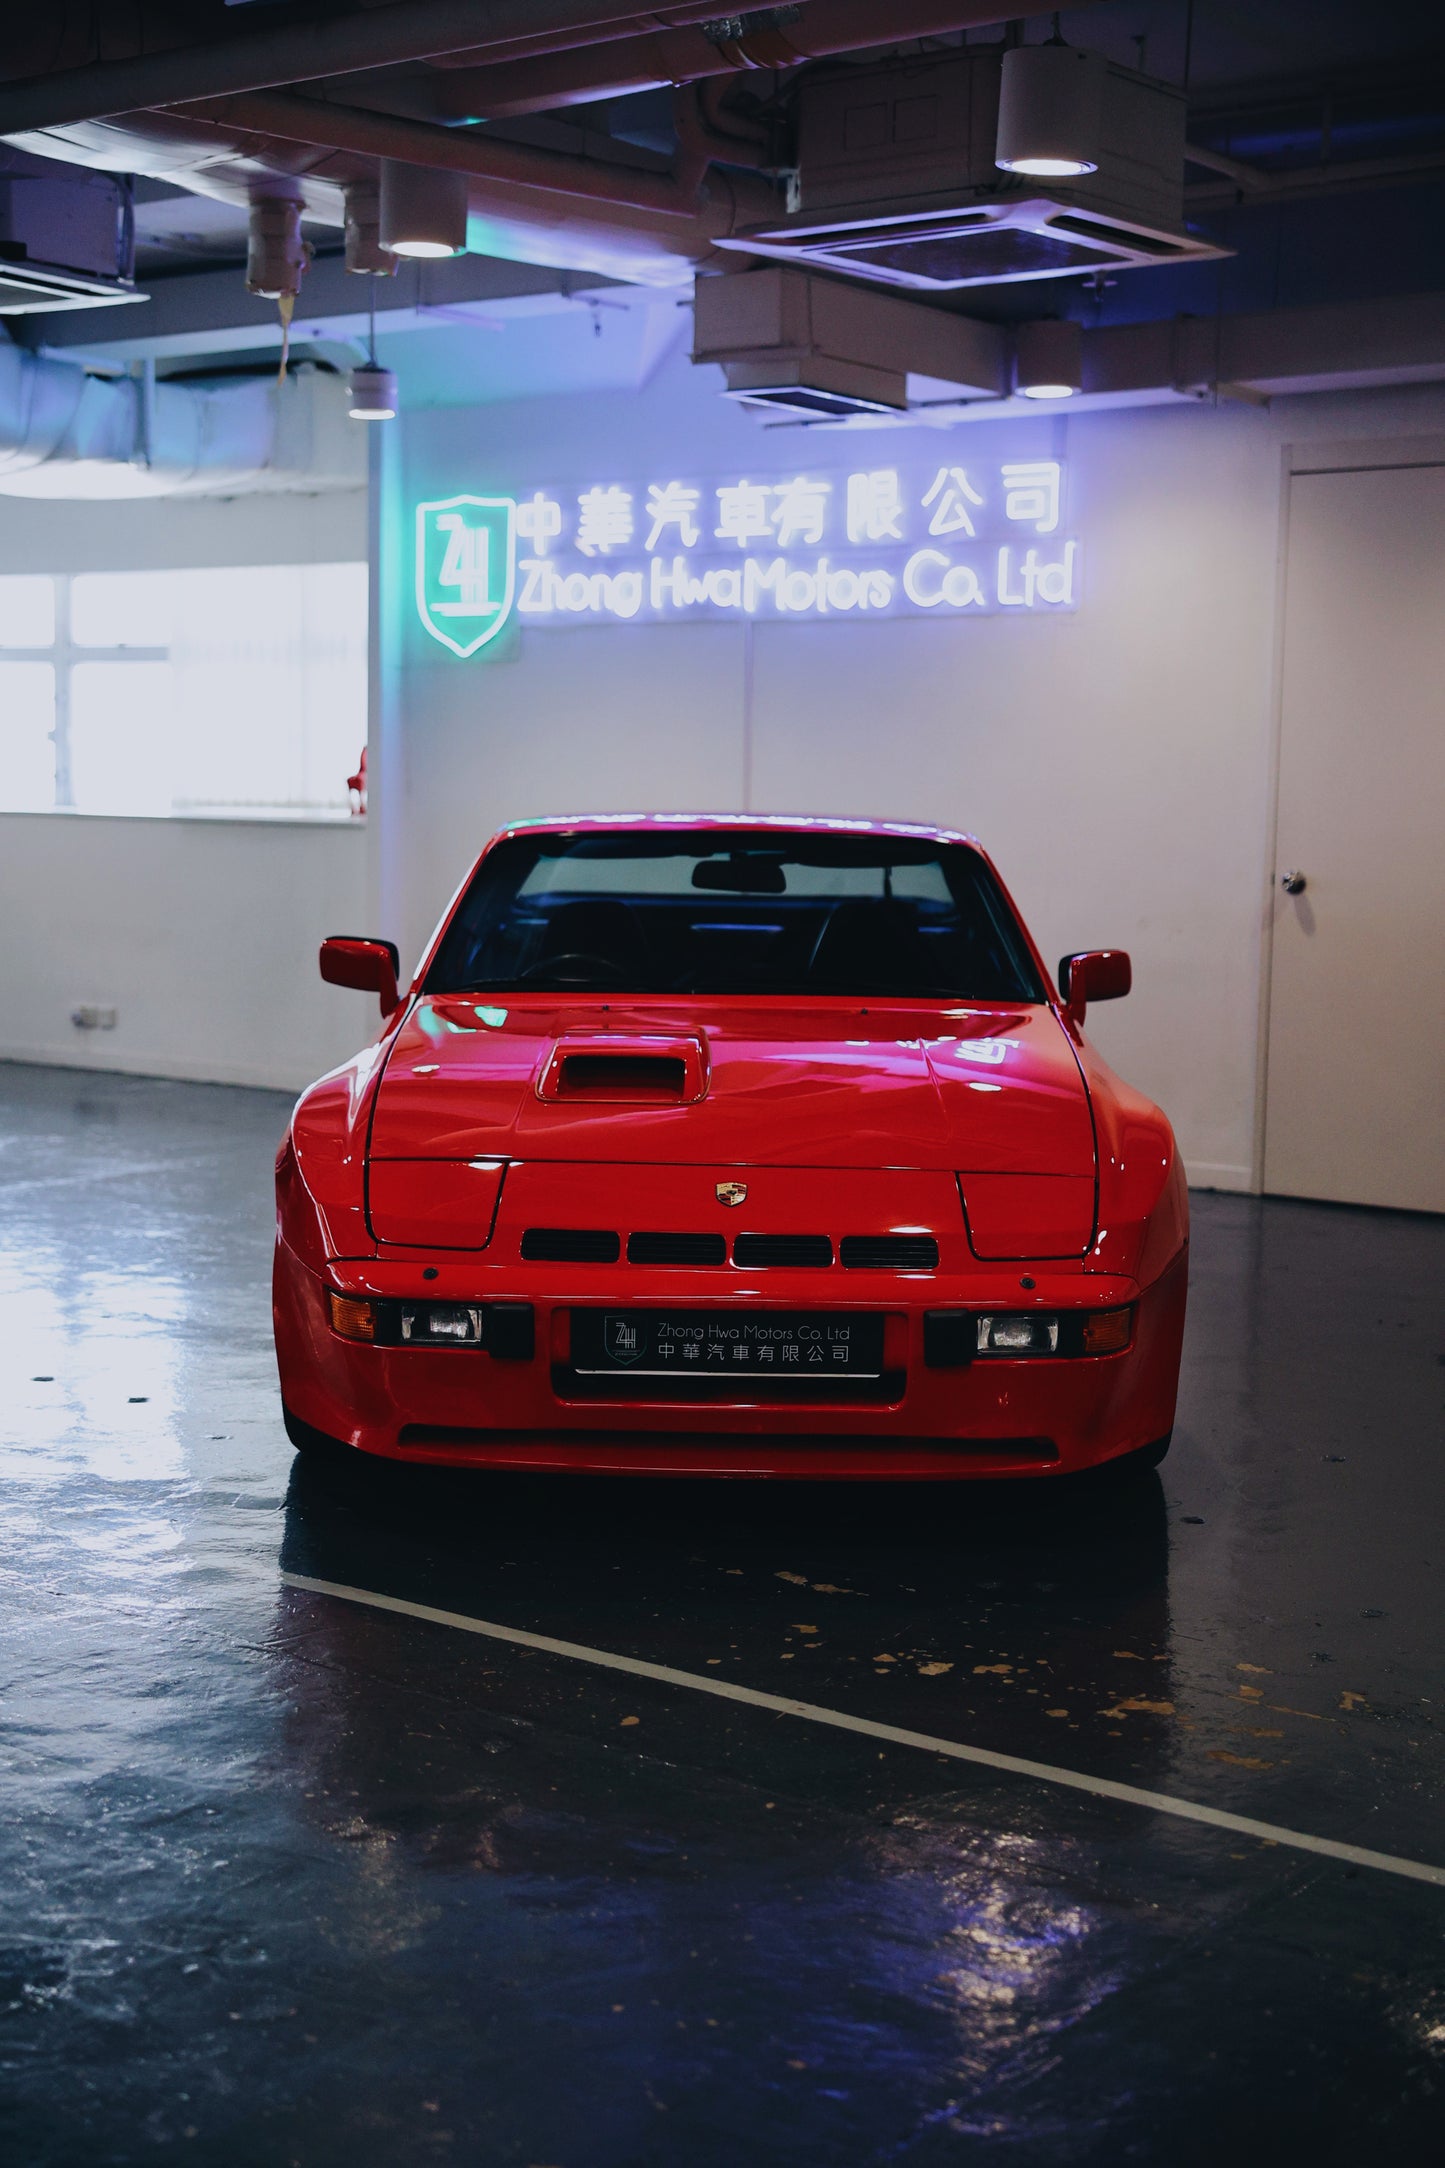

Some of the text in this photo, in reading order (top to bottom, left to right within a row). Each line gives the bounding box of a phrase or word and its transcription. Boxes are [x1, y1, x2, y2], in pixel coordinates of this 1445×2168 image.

[516, 461, 1060, 557] 中華汽車有限公司
[516, 559, 643, 618] Zhong
[650, 556, 742, 609] Hwa
[743, 557, 894, 613] Motors
[997, 541, 1075, 607] Ltd
[657, 1322, 850, 1340] Zhong Hwa Motors Co. Ltd
[658, 1342, 849, 1362] 中華汽車有限公司
